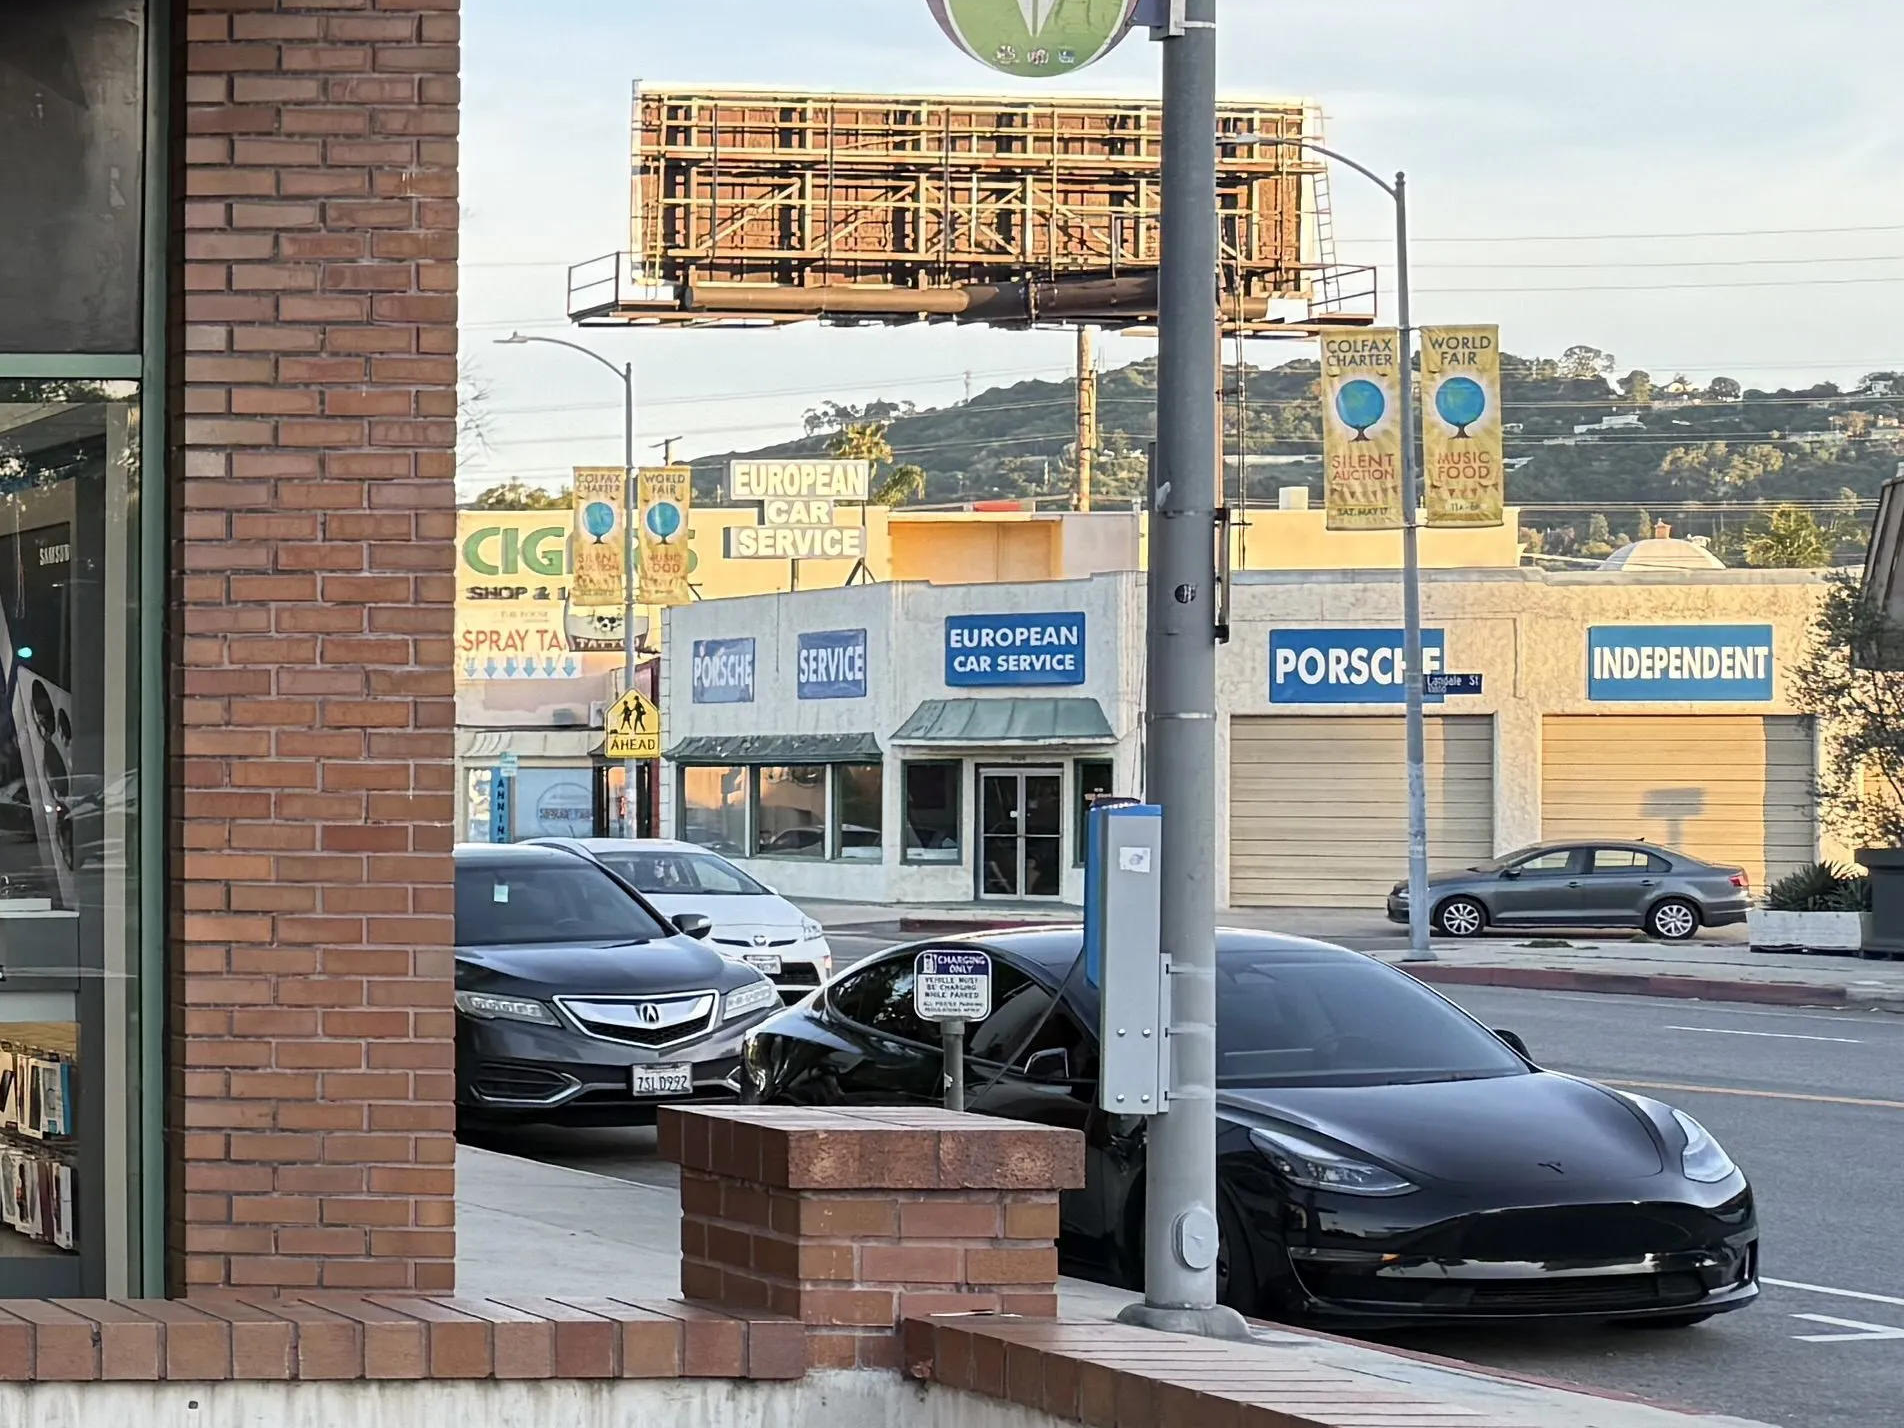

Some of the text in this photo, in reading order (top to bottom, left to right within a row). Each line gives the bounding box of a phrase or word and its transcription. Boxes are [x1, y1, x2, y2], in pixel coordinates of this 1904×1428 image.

[1326, 339, 1392, 354] COLFAX
[1429, 336, 1492, 350] WORLD
[1326, 354, 1392, 367] CHARTER
[1441, 351, 1478, 365] FAIR
[1332, 454, 1395, 468] SILENT
[1437, 451, 1490, 464] MUSIC
[644, 474, 685, 484] WORLD
[1333, 469, 1395, 481] AUCTION
[1438, 466, 1490, 480] FOOD
[734, 464, 865, 497] EUROPEAN
[652, 484, 677, 494] FAIR
[767, 500, 832, 524] CAR
[737, 528, 861, 556] SERVICE
[467, 587, 550, 600] SHOP &
[462, 629, 529, 652] SPRAY
[950, 626, 1079, 649] EUROPEAN
[693, 651, 752, 686] PORSCHE
[799, 646, 864, 683] SERVICE
[953, 654, 1075, 672] CAR SERVICE
[1593, 646, 1769, 680] INDEPENDENT
[610, 739, 655, 751] AHEAD
[938, 955, 986, 965] CHARGING
[949, 964, 973, 973] ONLY
